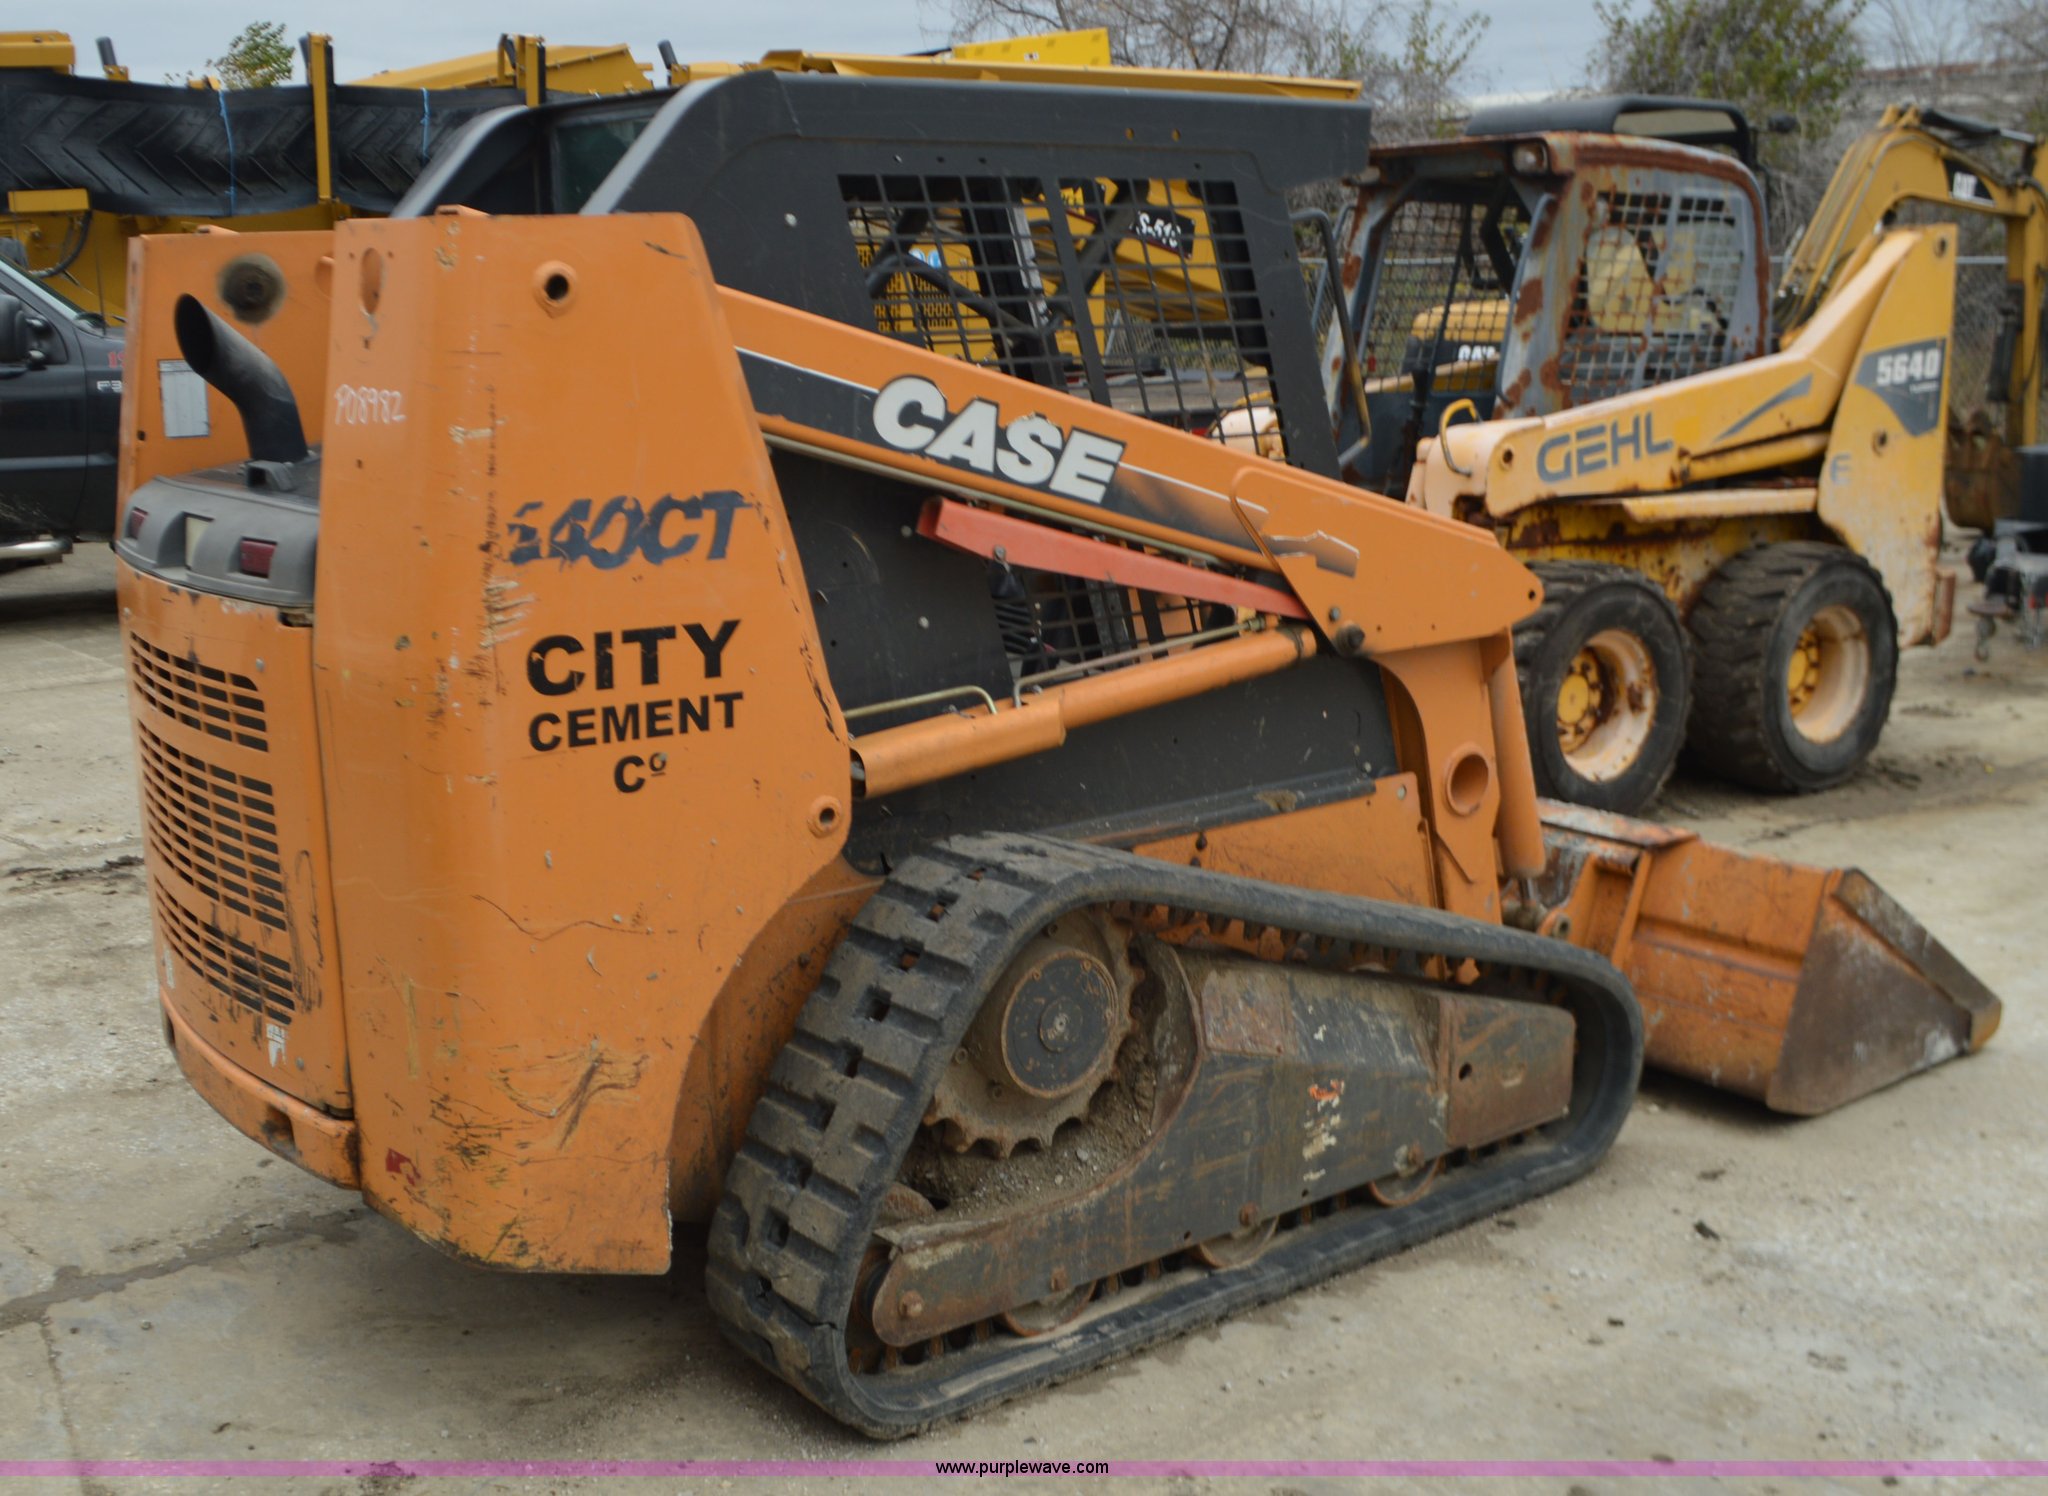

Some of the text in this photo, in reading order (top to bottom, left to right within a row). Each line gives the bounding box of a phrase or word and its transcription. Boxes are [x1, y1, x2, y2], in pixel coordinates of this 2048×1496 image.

[1876, 348, 1940, 387] 5640
[872, 375, 1126, 504] CASE
[1537, 411, 1673, 484] GEHL
[526, 619, 741, 697] CITY
[528, 692, 744, 752] CEMENT
